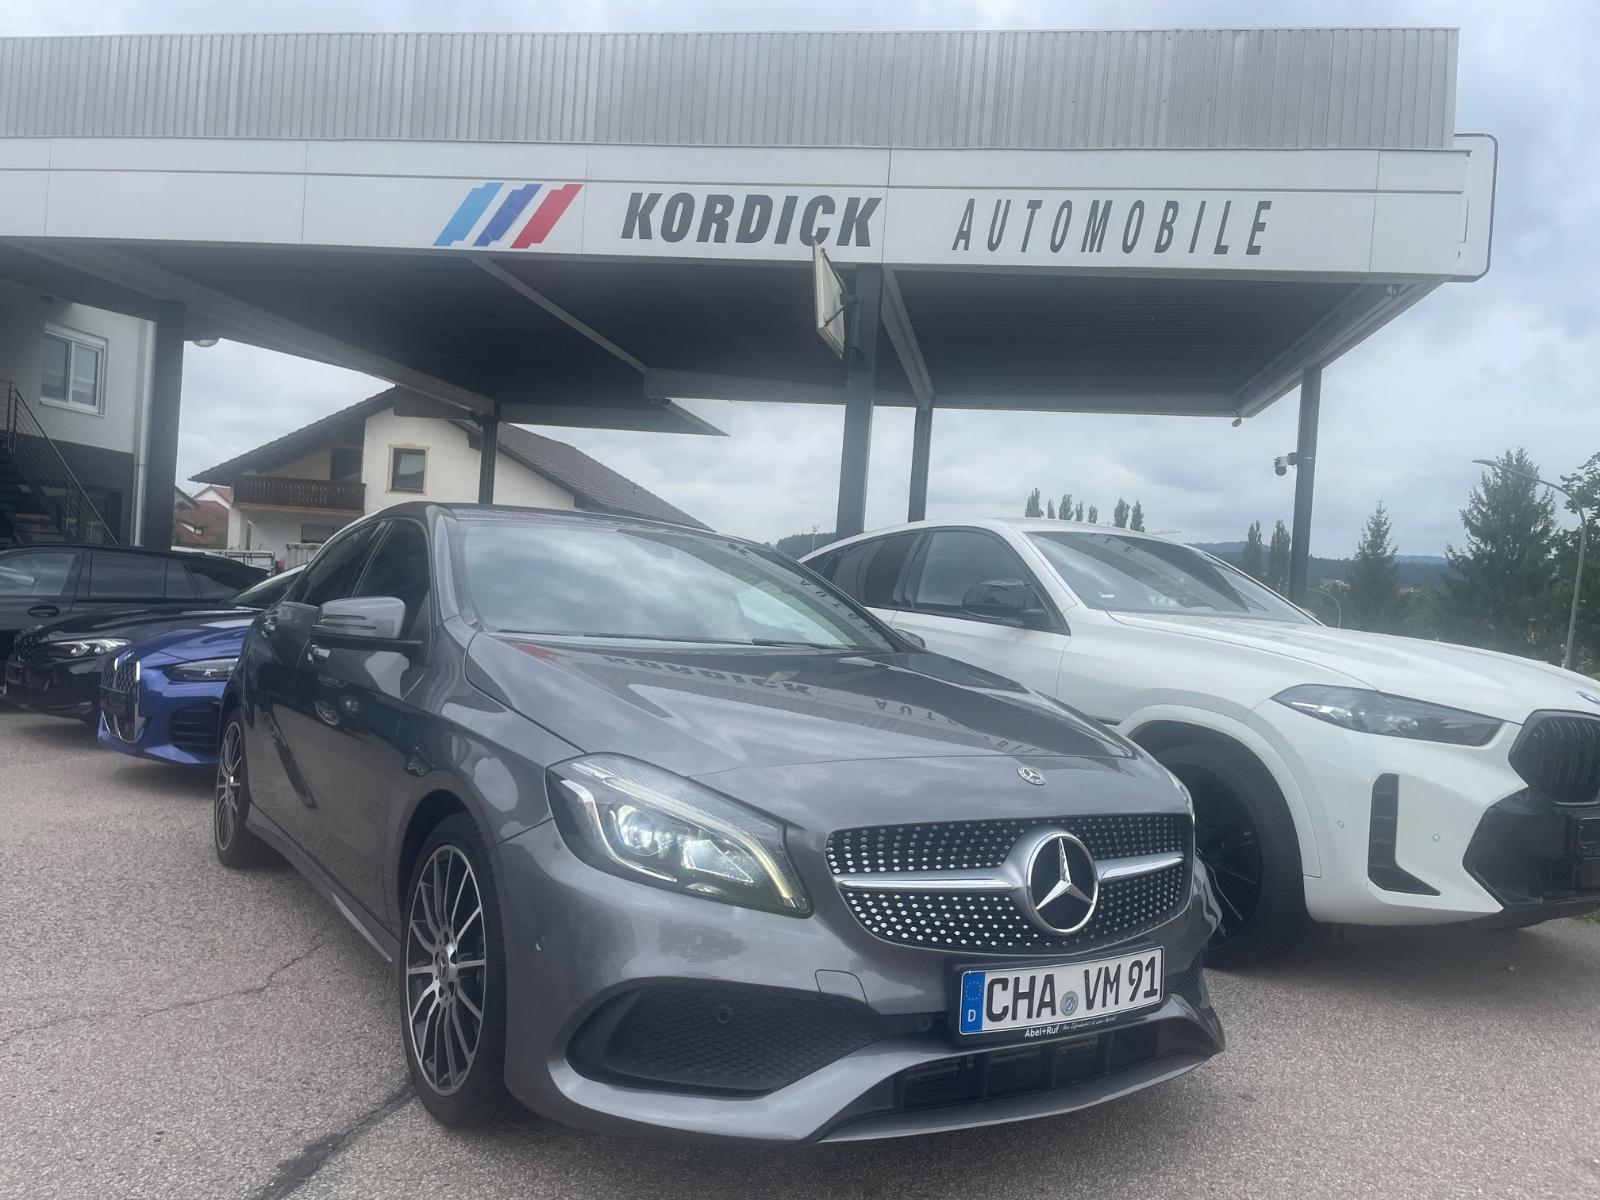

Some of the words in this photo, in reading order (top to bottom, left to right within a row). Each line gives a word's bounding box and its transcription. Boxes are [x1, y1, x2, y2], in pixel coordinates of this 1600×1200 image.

[621, 192, 883, 247] KORDICK
[952, 198, 1272, 255] AUTOMOBILE
[986, 974, 1057, 1022] CHA
[1084, 963, 1121, 1010] VM
[1128, 956, 1158, 1002] 91
[967, 1009, 976, 1022] D
[1025, 1025, 1059, 1037] Abel+Ruf
